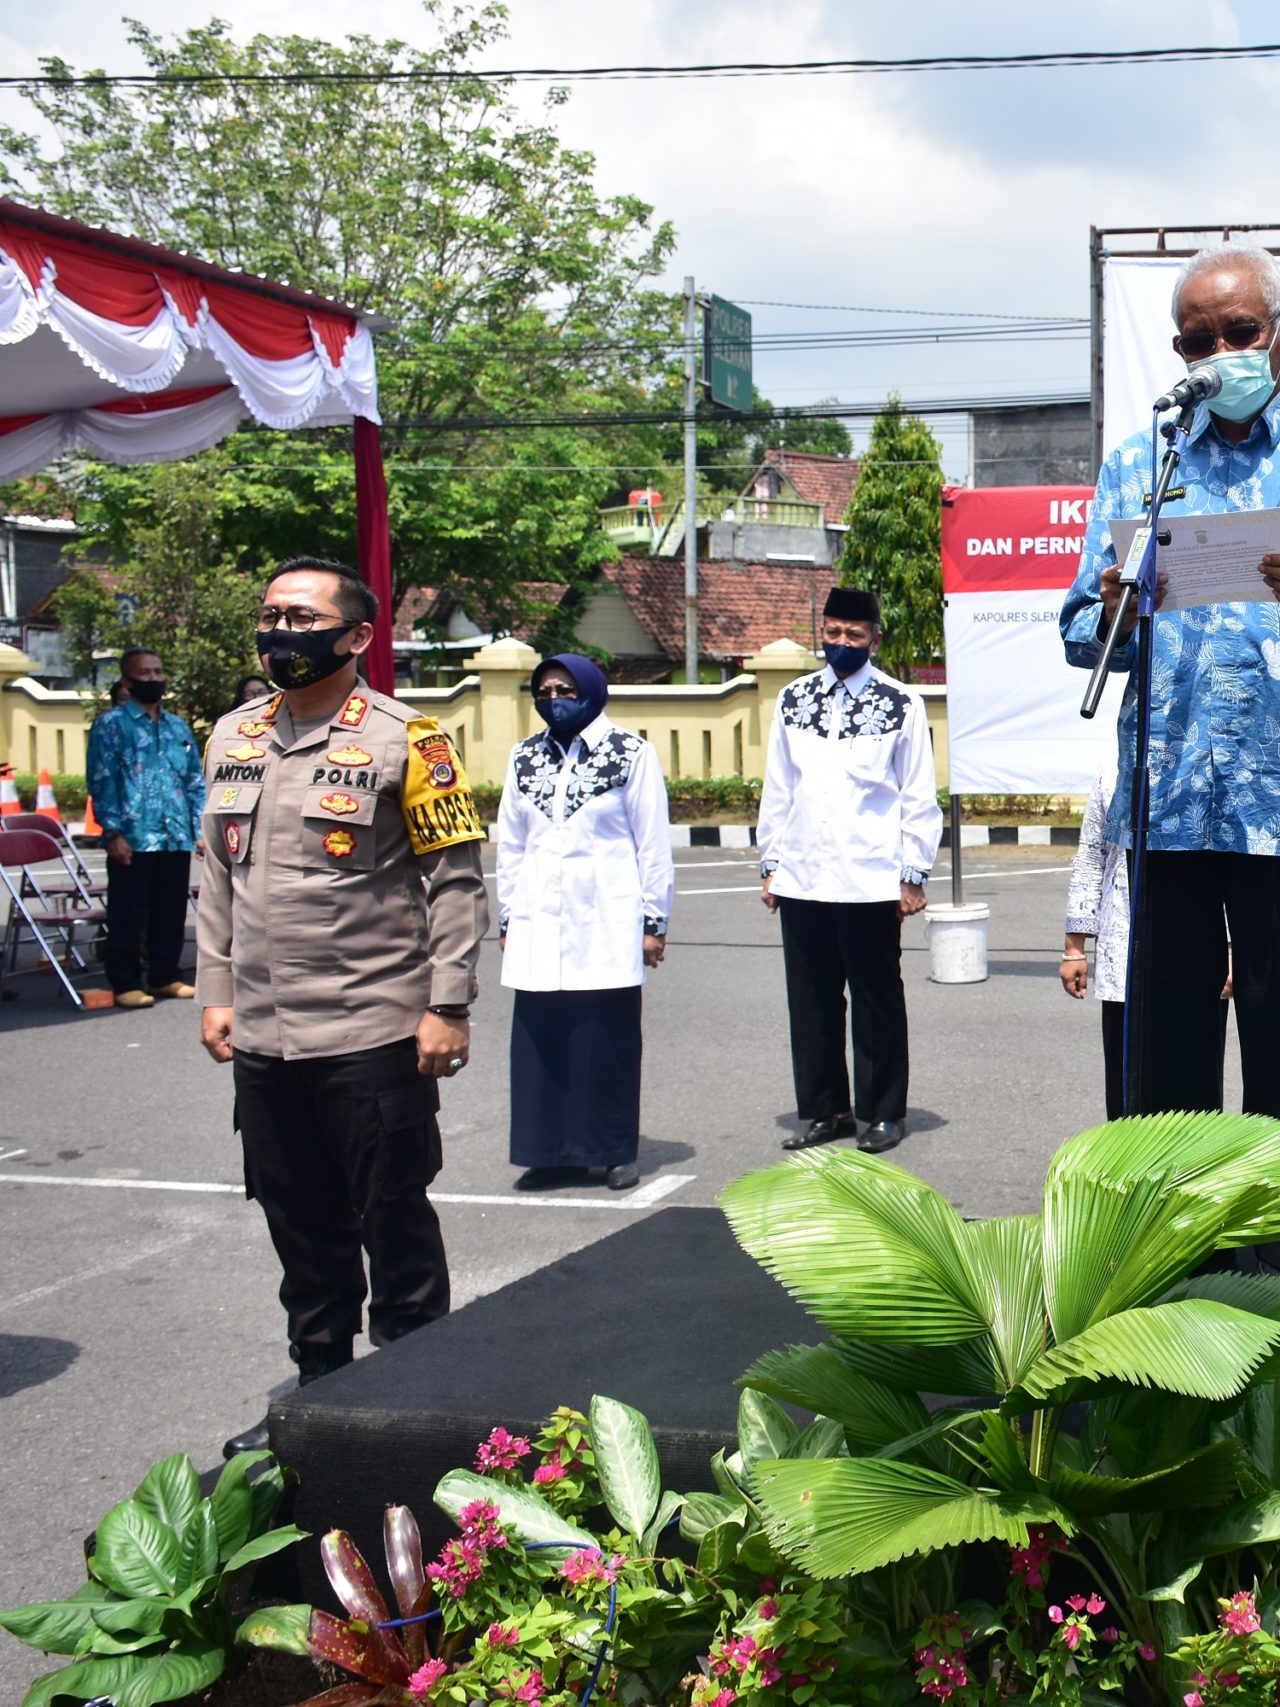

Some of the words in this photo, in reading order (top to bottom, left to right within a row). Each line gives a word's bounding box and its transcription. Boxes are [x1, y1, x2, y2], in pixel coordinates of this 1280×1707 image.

[966, 537, 1013, 556] DAN
[1020, 536, 1086, 555] PERN
[973, 612, 1028, 623] KAPOLRES
[1031, 612, 1059, 622] SLEM
[214, 764, 266, 782] ANTON
[313, 768, 378, 789] POLRI
[406, 803, 441, 846] KA
[433, 792, 473, 838] OPS
